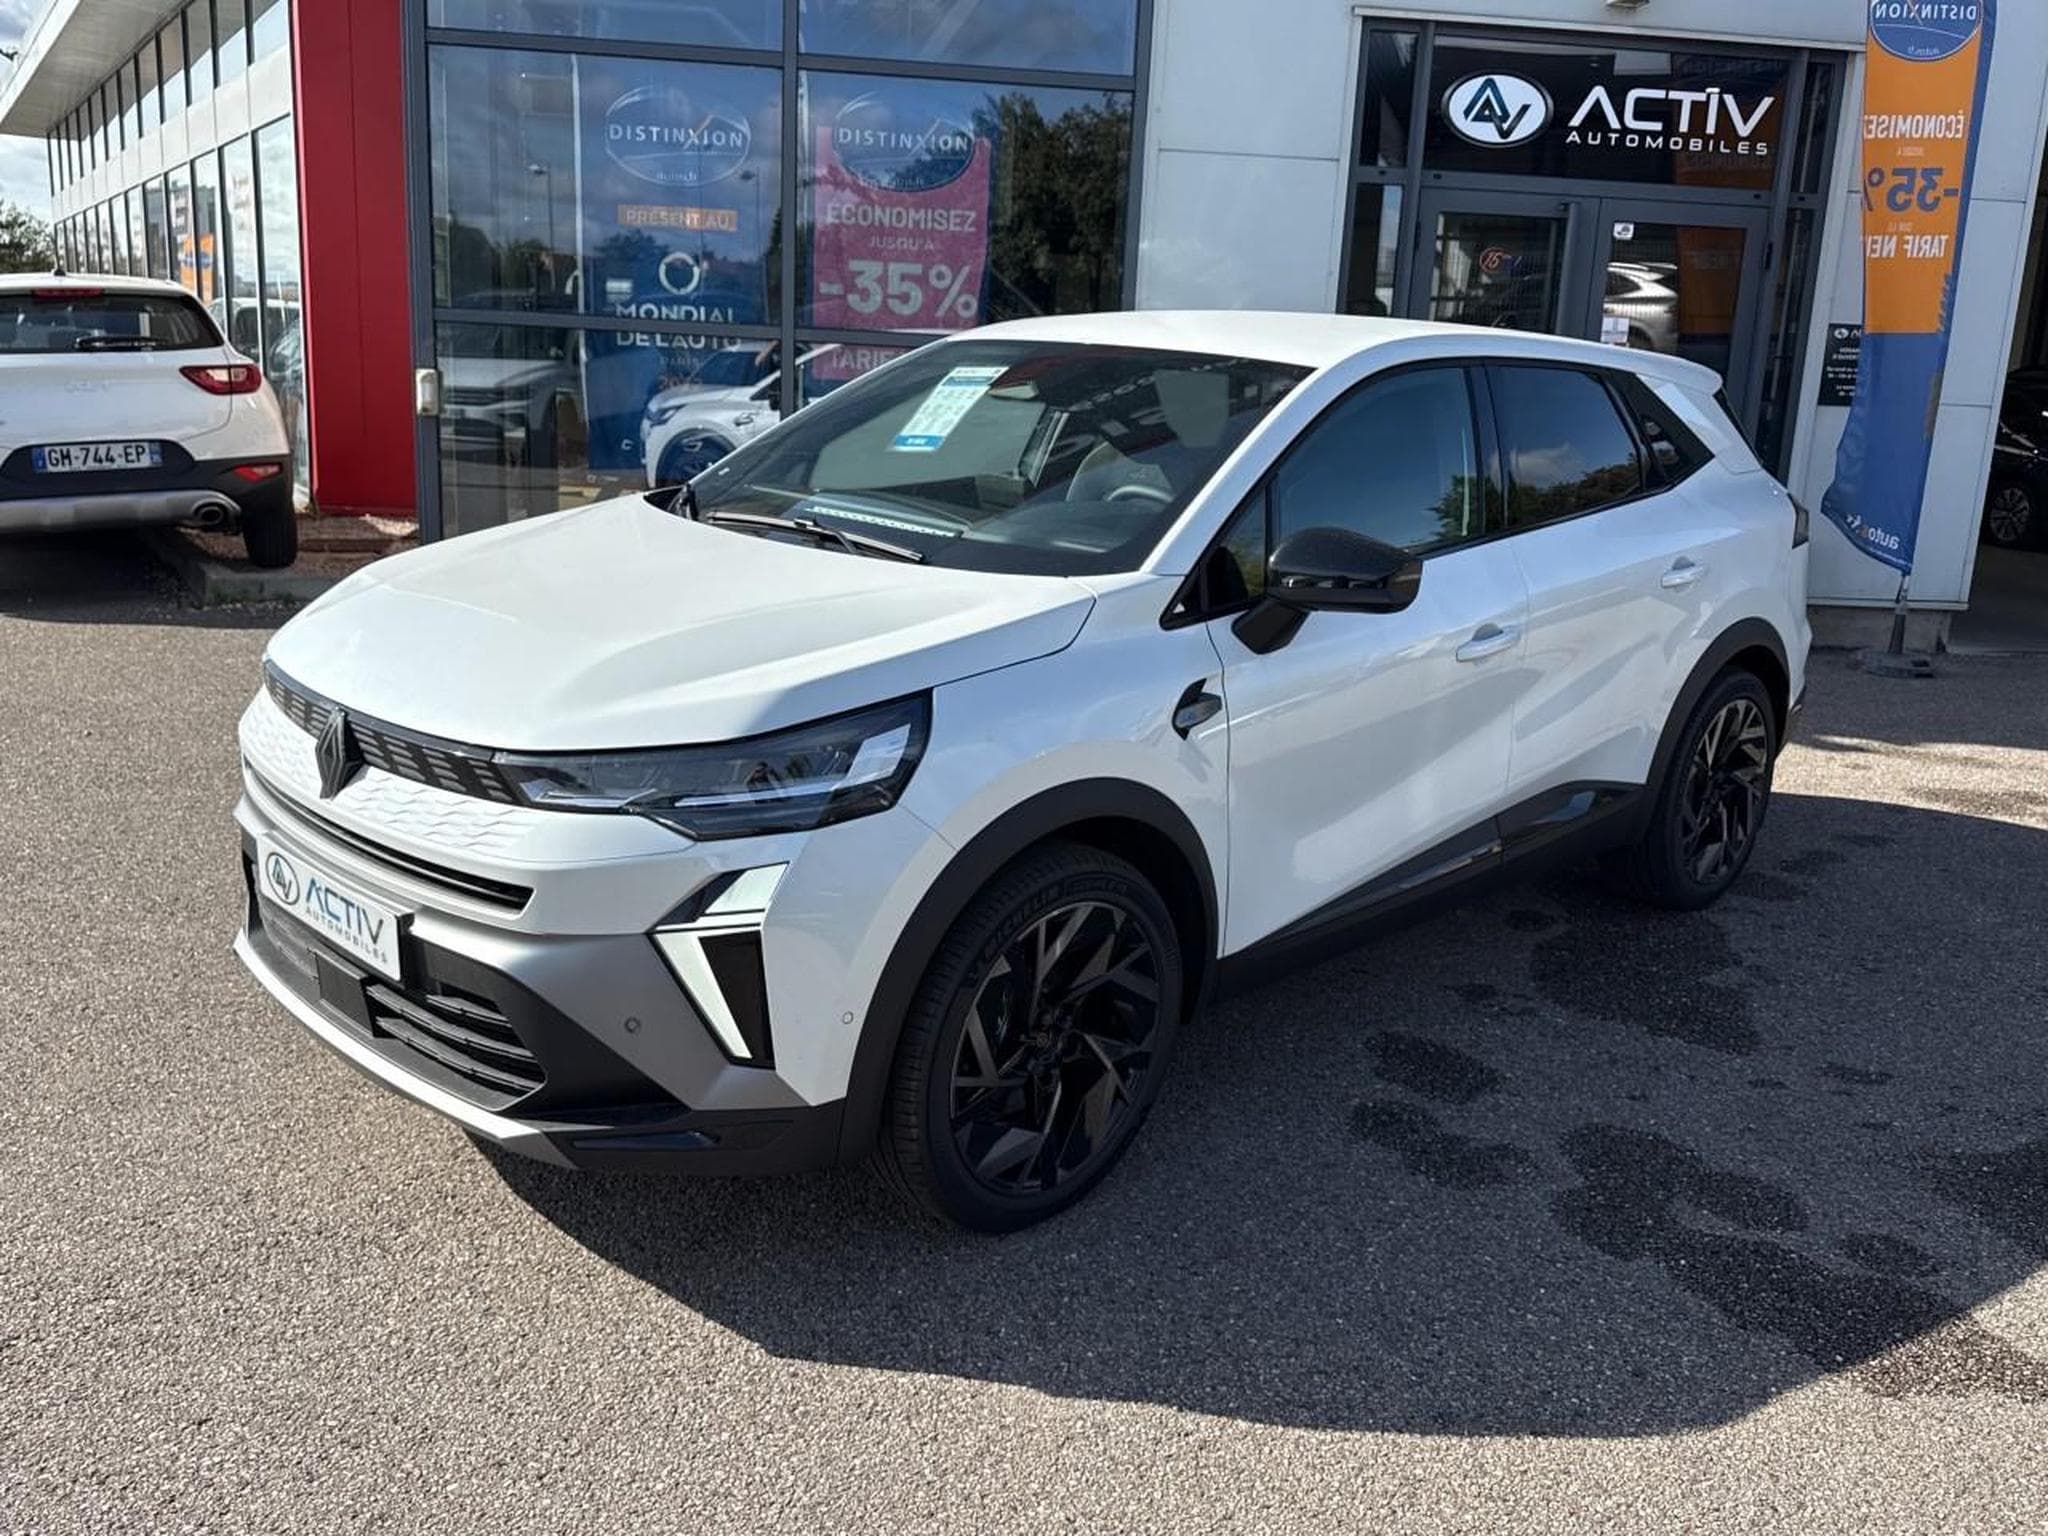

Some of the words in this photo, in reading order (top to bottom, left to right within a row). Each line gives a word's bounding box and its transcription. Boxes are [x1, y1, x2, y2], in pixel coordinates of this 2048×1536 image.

[609, 123, 743, 148] DISTINXION
[838, 126, 969, 151] DISTINXION
[1565, 130, 1768, 155] AUTOMOBILES
[818, 258, 979, 319] -35%
[305, 877, 384, 945] ACTIV
[305, 906, 388, 964] AUTOMOBILES
